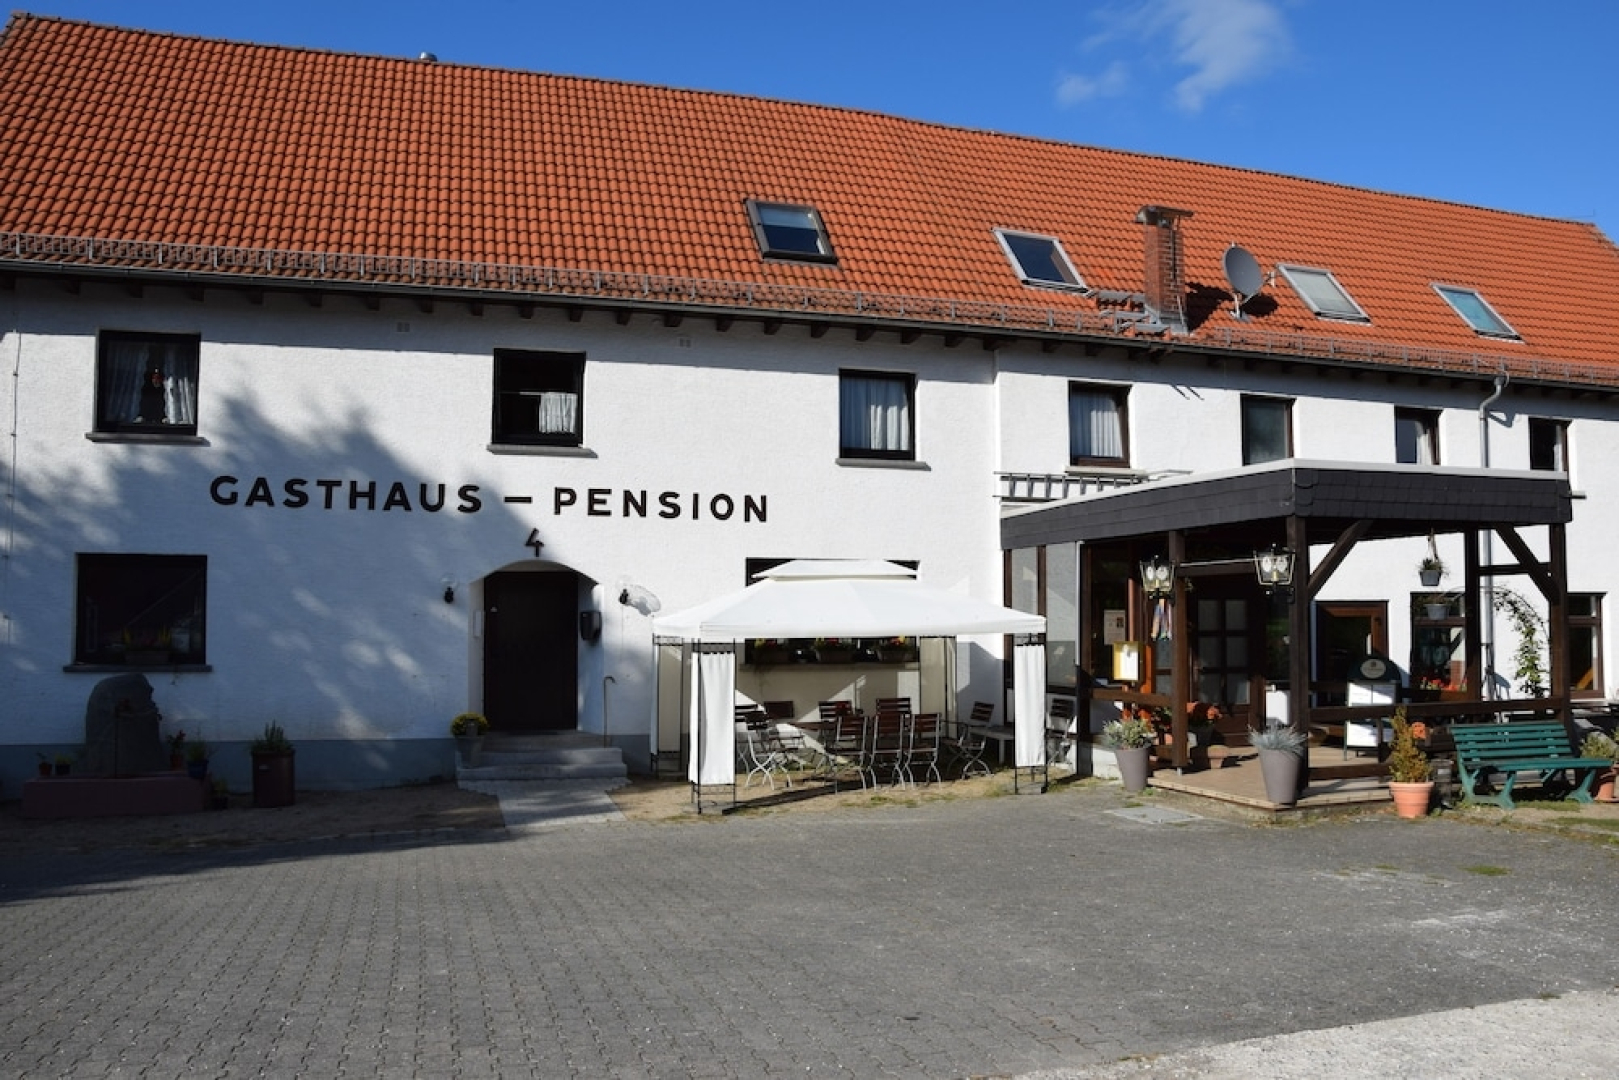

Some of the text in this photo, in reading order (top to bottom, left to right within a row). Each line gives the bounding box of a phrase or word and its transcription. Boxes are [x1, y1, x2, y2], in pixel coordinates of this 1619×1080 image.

[210, 475, 482, 514] GASTHAUS
[554, 487, 767, 522] PENSION
[525, 528, 545, 558] 4
